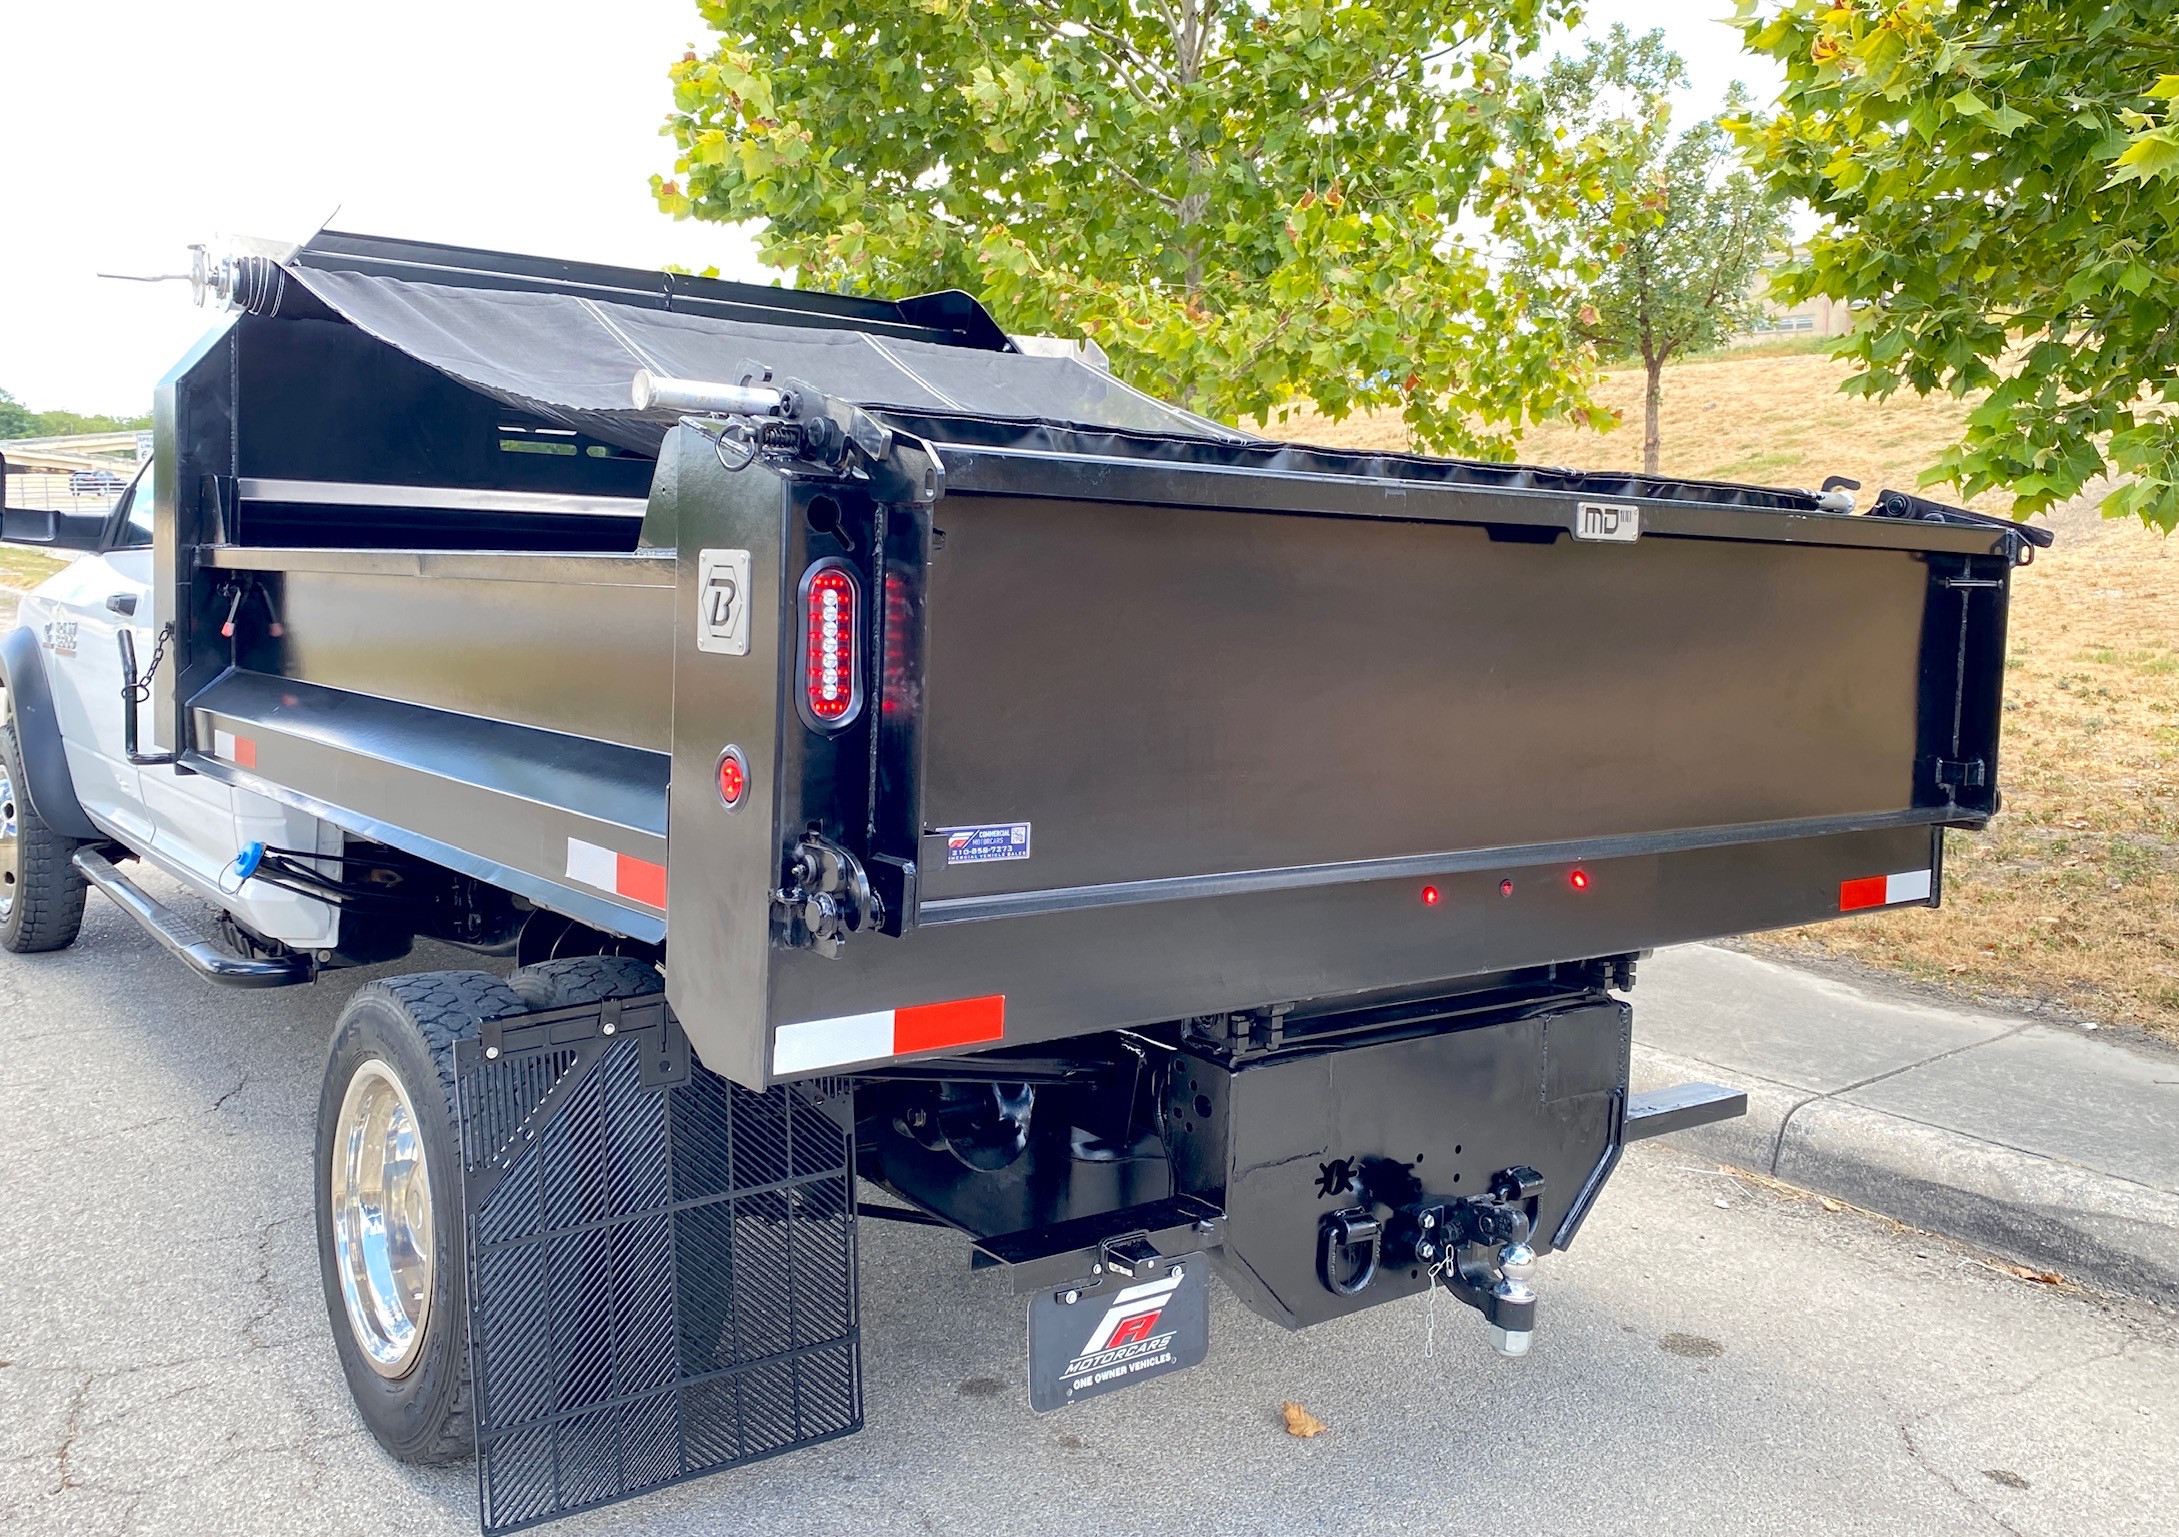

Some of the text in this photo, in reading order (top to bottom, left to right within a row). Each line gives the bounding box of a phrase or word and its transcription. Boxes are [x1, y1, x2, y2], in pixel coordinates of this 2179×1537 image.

[709, 578, 736, 627] B
[972, 837, 1003, 845] MOTORCARS
[979, 830, 1010, 838] COMMERCIAL
[1064, 1335, 1173, 1375] MOTORCARS
[1073, 1352, 1172, 1391] ONE OWNER VEHICLES
